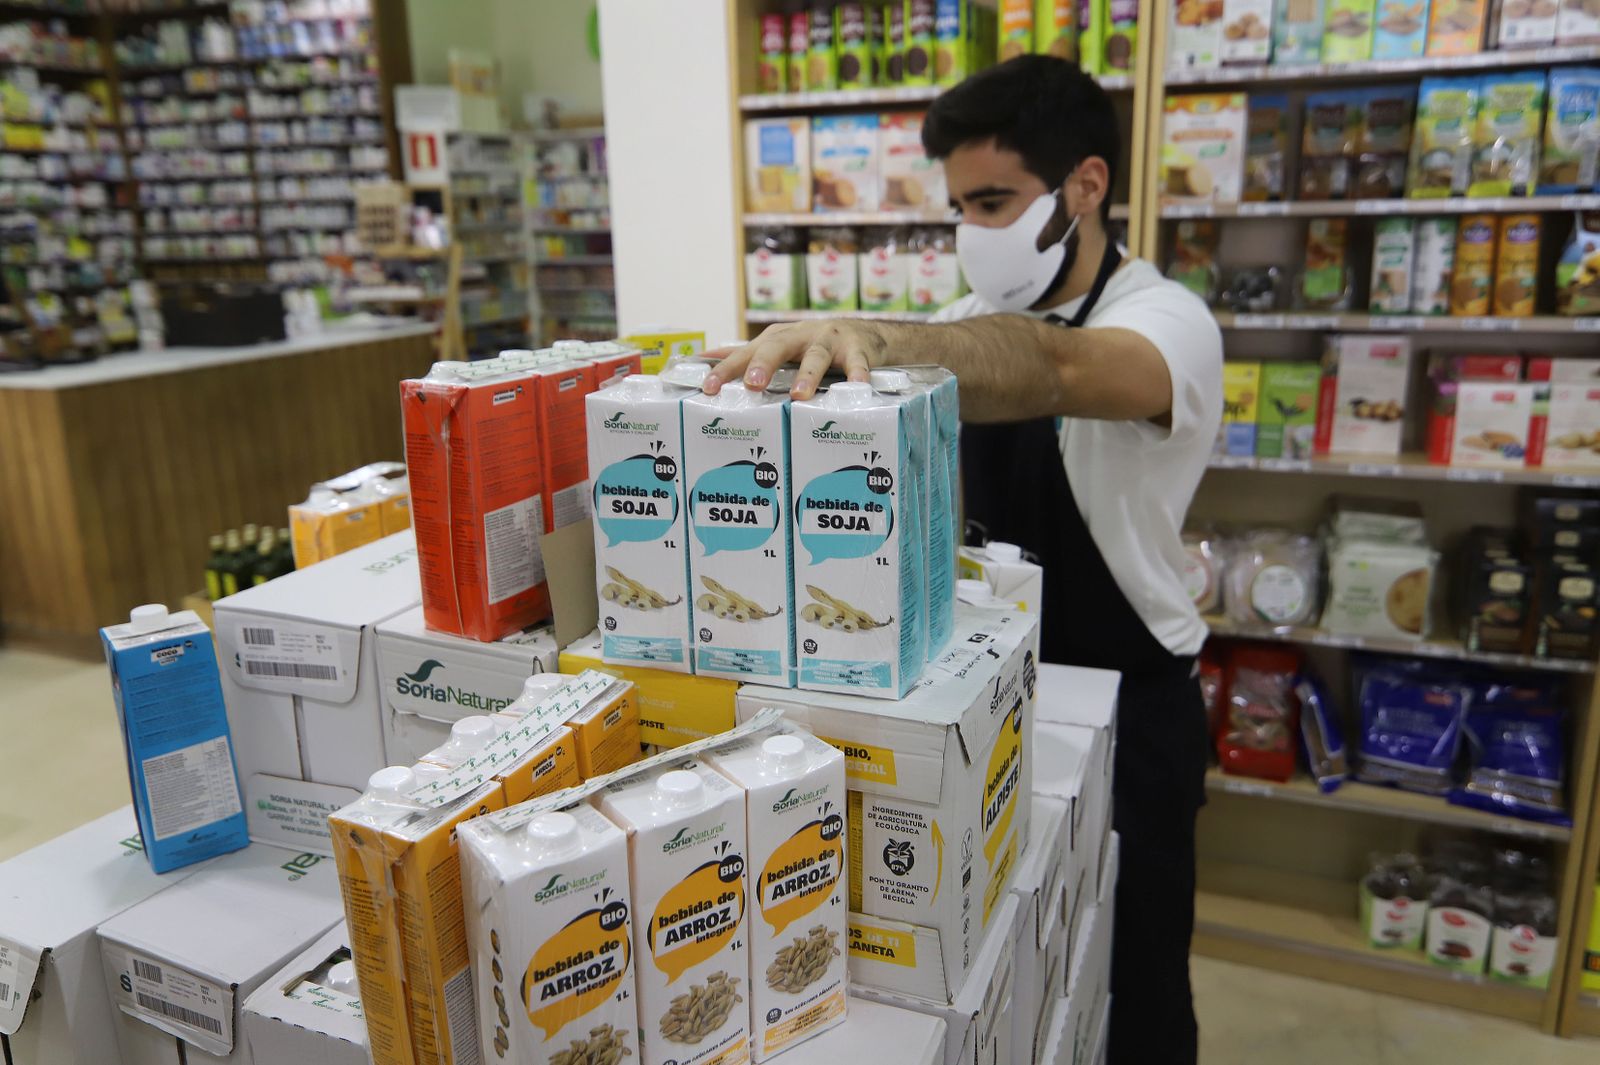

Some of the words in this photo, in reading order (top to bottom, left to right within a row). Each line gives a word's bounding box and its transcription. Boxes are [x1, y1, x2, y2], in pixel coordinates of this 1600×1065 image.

[604, 420, 659, 432] SoriaNatural
[702, 426, 761, 437] SoriaNatural
[812, 430, 876, 441] SoriaNatural
[656, 464, 675, 474] BIO
[756, 470, 776, 481] BIO
[869, 476, 892, 487] BIO
[602, 484, 648, 498] bebida
[652, 488, 668, 499] de
[698, 492, 748, 505] bebida
[752, 495, 770, 506] de
[612, 500, 658, 516] SOJA
[806, 498, 860, 511] bebida
[864, 500, 884, 513] de
[709, 508, 758, 524] SOJA
[818, 514, 870, 532] SOJA
[844, 746, 872, 760] BIO,
[988, 759, 1010, 797] bebida
[1010, 744, 1018, 763] de
[270, 794, 292, 804] SORIA
[772, 784, 829, 813] SoriaNatural
[986, 763, 1018, 832] ALPISTE
[872, 806, 923, 820] INGREDIENTES
[822, 820, 841, 836] BIO
[875, 822, 920, 835] ECOLÓGICA
[878, 815, 928, 829] AGRICULTURA
[662, 823, 726, 853] SoriaNatural
[720, 862, 742, 877] BIO
[767, 855, 815, 883] bebida
[818, 848, 836, 862] de
[534, 869, 607, 903] SoriaNatural
[772, 864, 830, 900] ARROZ
[799, 877, 837, 898] integral
[869, 876, 885, 884] PON
[896, 882, 929, 892] GRANITO
[882, 894, 914, 905] RECICLA
[601, 907, 626, 926] BIO
[658, 900, 713, 928] bebida
[718, 890, 736, 904] de
[664, 907, 732, 947] ARROZ
[696, 920, 737, 944] integral
[534, 950, 594, 982] bebida
[598, 939, 620, 955] de
[540, 956, 616, 1001] ARROZ
[576, 970, 622, 997] integral
